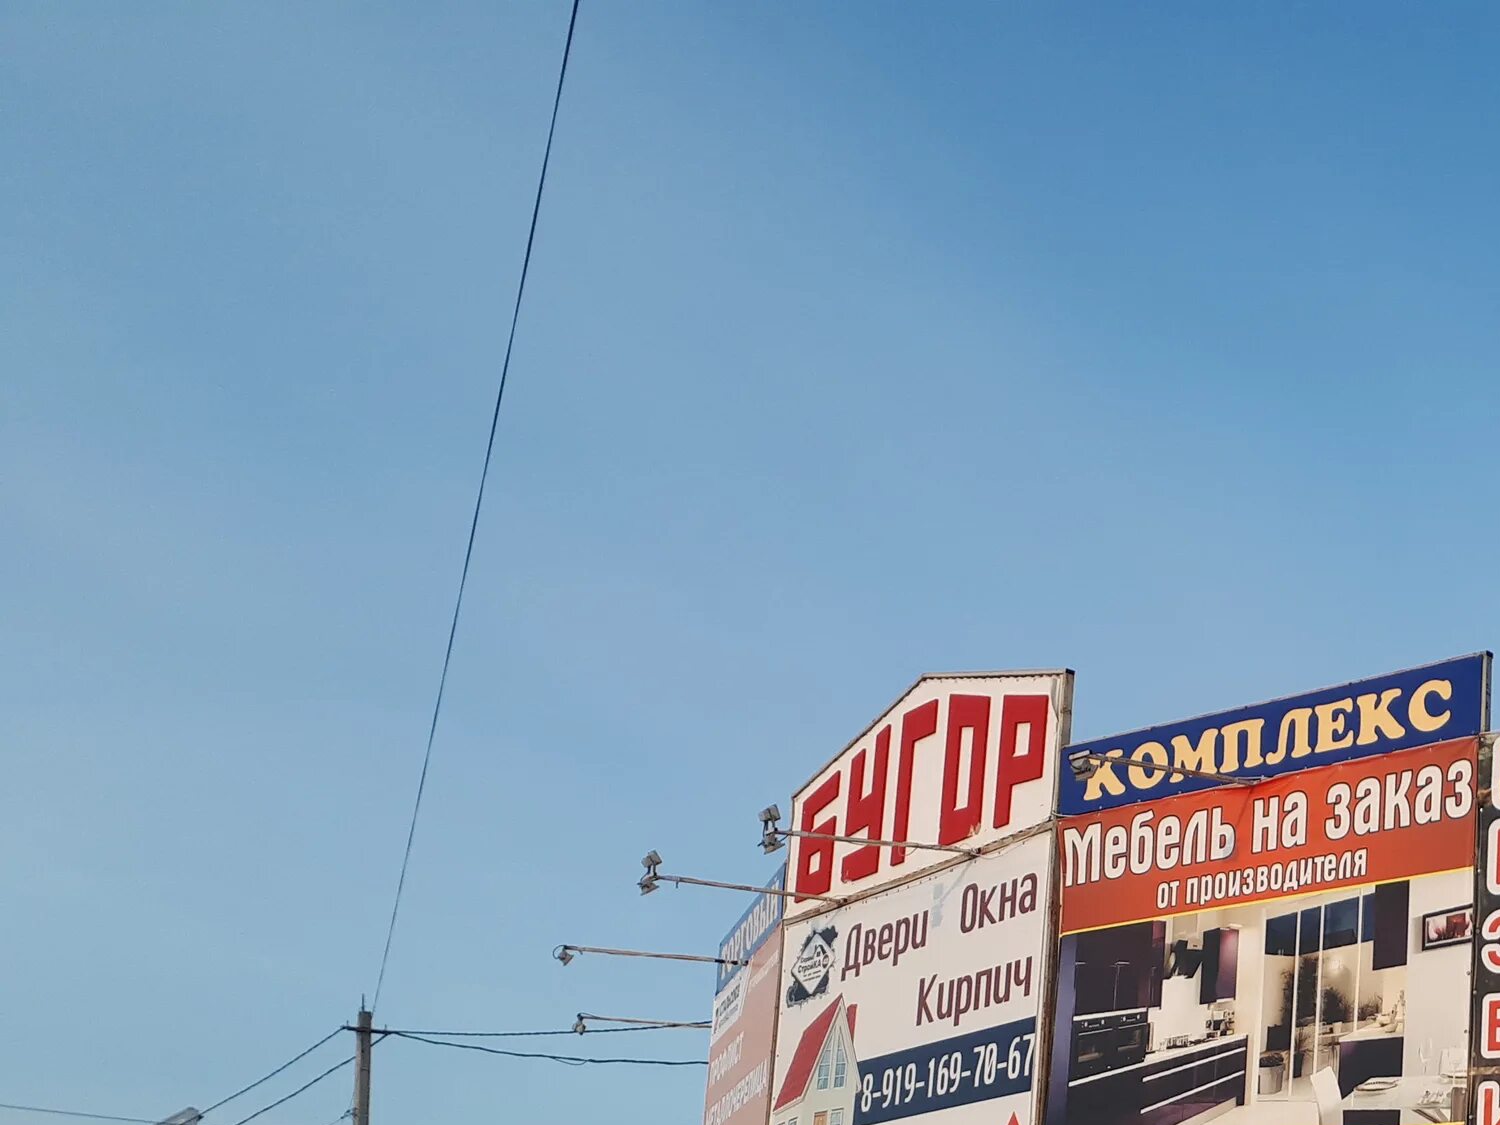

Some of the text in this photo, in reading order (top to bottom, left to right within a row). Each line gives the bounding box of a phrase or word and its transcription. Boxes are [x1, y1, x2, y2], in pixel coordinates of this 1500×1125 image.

[1081, 679, 1453, 801] КОМПЛЕКС
[794, 694, 1050, 903] БУГОР
[1062, 757, 1475, 887] Мебель на заказ
[720, 876, 780, 981] ТОРГОВЫЙ
[841, 909, 930, 981] Двери
[959, 872, 1038, 934] Окна
[1156, 847, 1368, 910] от производителя
[915, 956, 1033, 1027] Кирпич
[860, 1033, 1036, 1113] 8-919-169-70-67
